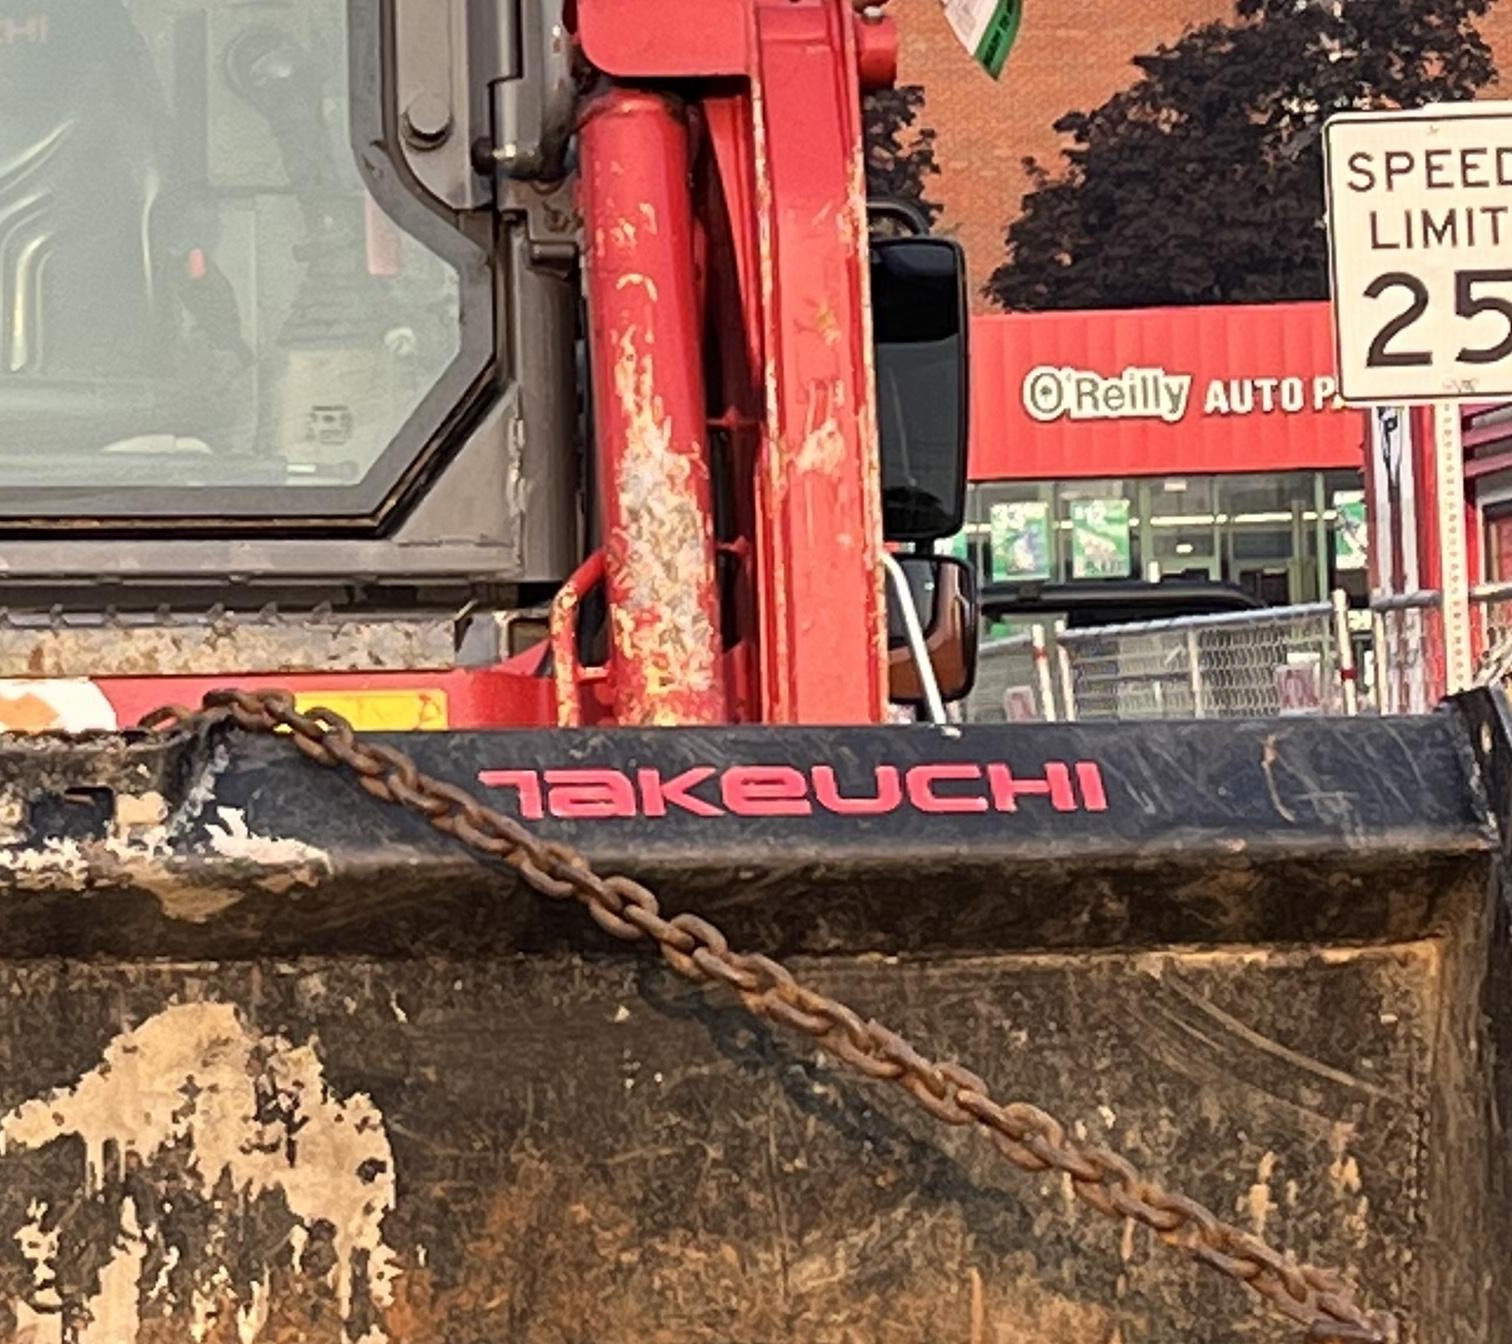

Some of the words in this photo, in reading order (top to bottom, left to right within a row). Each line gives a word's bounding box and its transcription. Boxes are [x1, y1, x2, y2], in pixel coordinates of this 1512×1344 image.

[1369, 207, 1509, 249] LIMIT
[1362, 269, 1512, 368] 25
[1204, 376, 1304, 416] AUTO
